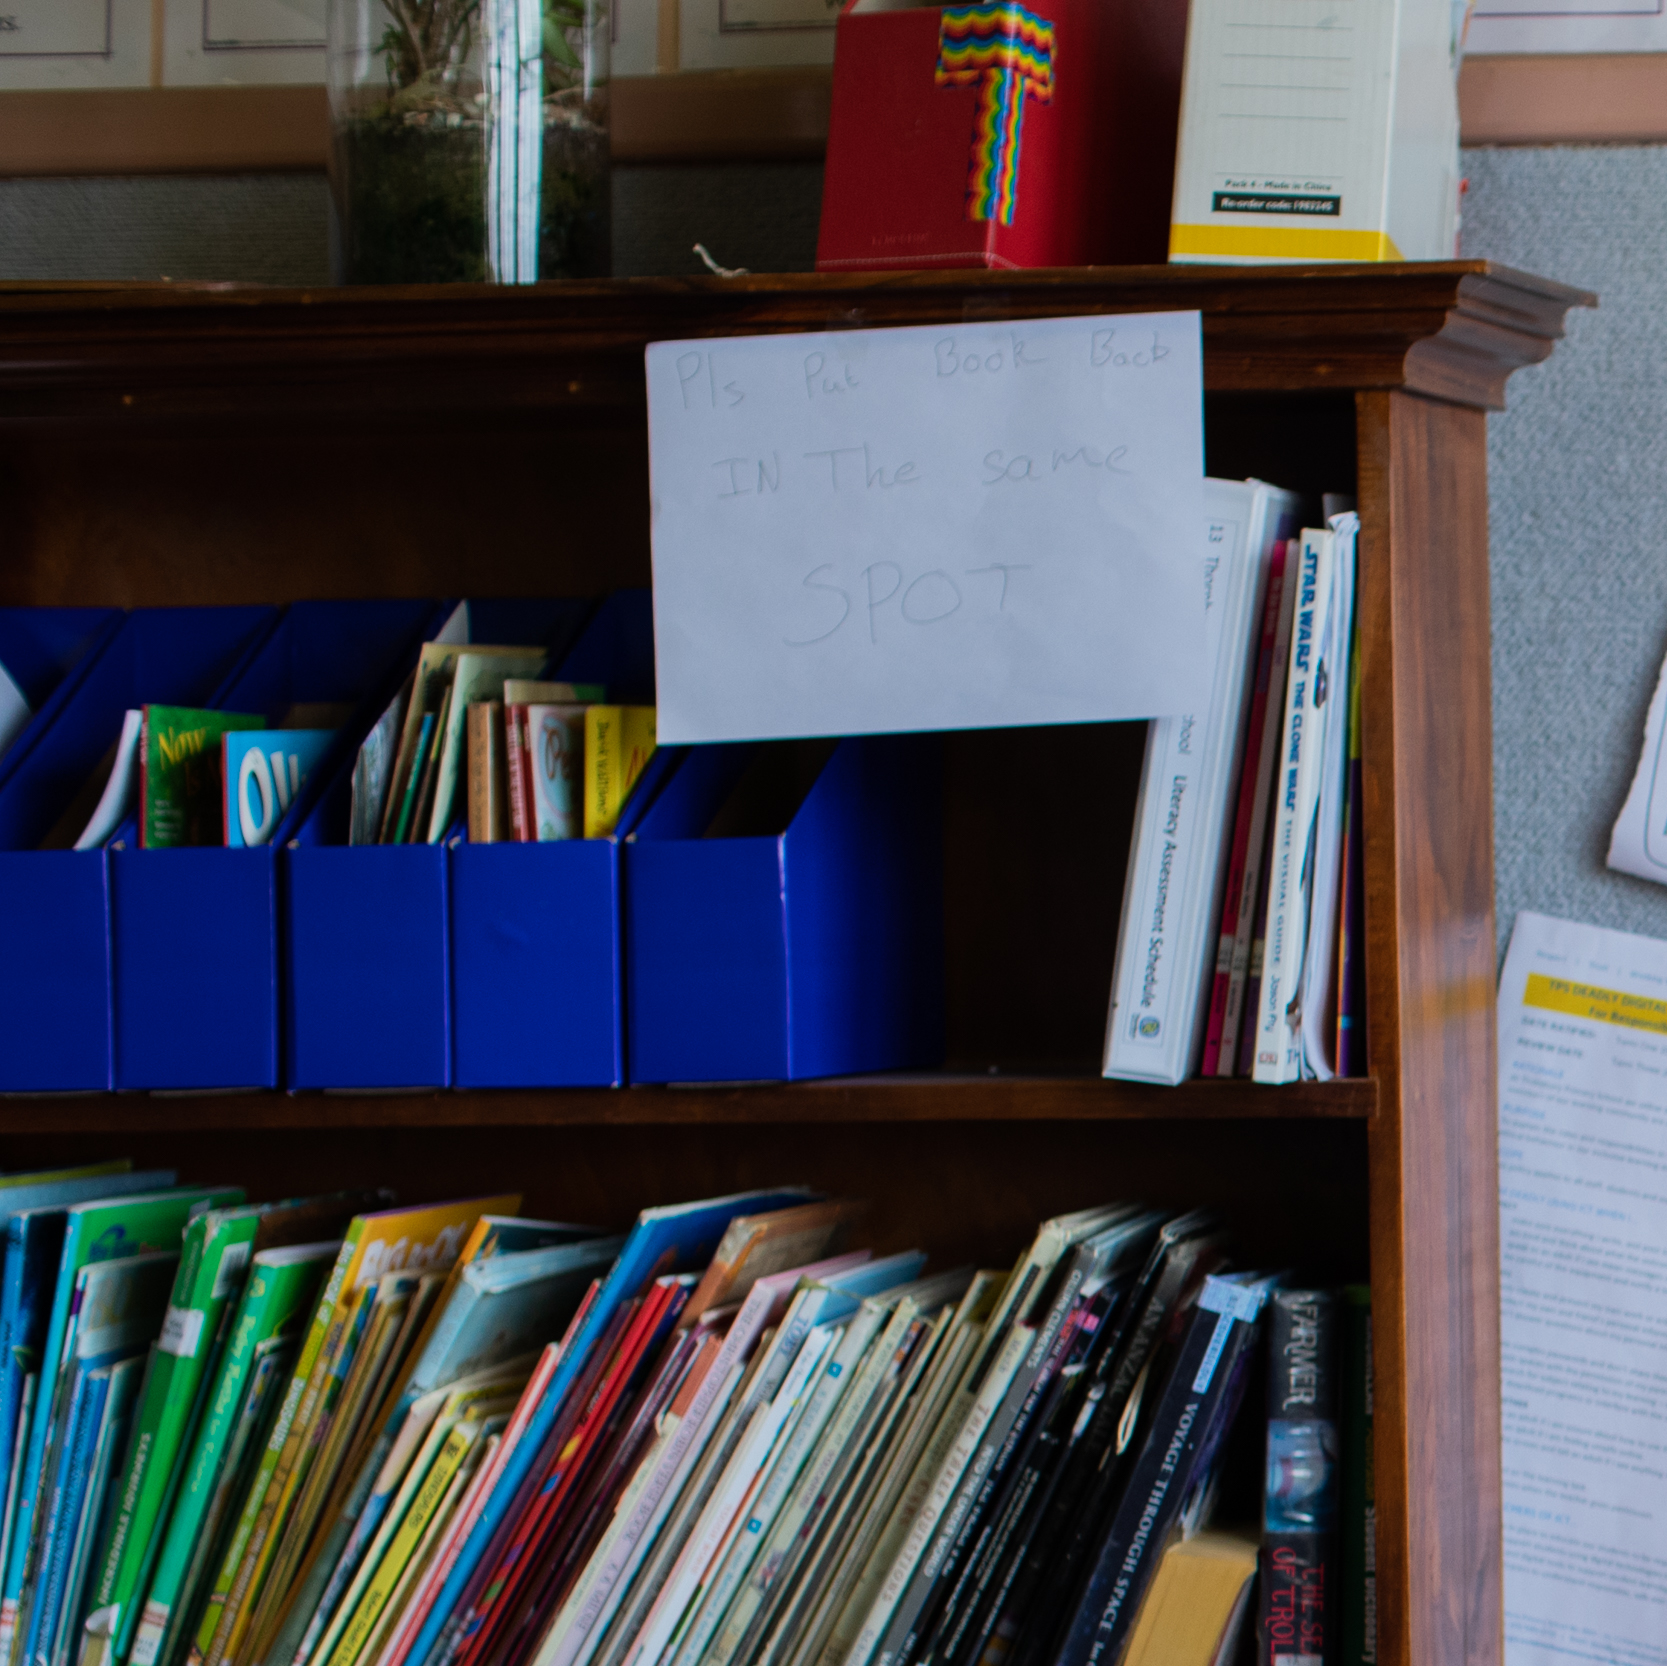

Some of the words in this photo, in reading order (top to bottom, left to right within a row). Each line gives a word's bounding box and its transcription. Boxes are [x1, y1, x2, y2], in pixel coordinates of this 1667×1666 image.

[1301, 542, 1320, 590] STAR
[782, 559, 1034, 648] SPOT
[1294, 617, 1313, 671] WARS
[1289, 713, 1304, 769] CLONE
[1163, 774, 1188, 838] Literacy
[1284, 771, 1300, 815] WARS
[1150, 842, 1179, 931] Assessment
[1139, 935, 1166, 1009] Schedule
[1547, 978, 1572, 999] TPS
[1571, 984, 1619, 1008] DEADLY
[1282, 1293, 1322, 1412] FARMER
[1169, 1402, 1199, 1475] VOYAGE
[1124, 1473, 1171, 1577] THROUGH
[1270, 1546, 1297, 1581] OF
[1306, 1562, 1326, 1605] THE
[1098, 1579, 1130, 1632] SPACE
